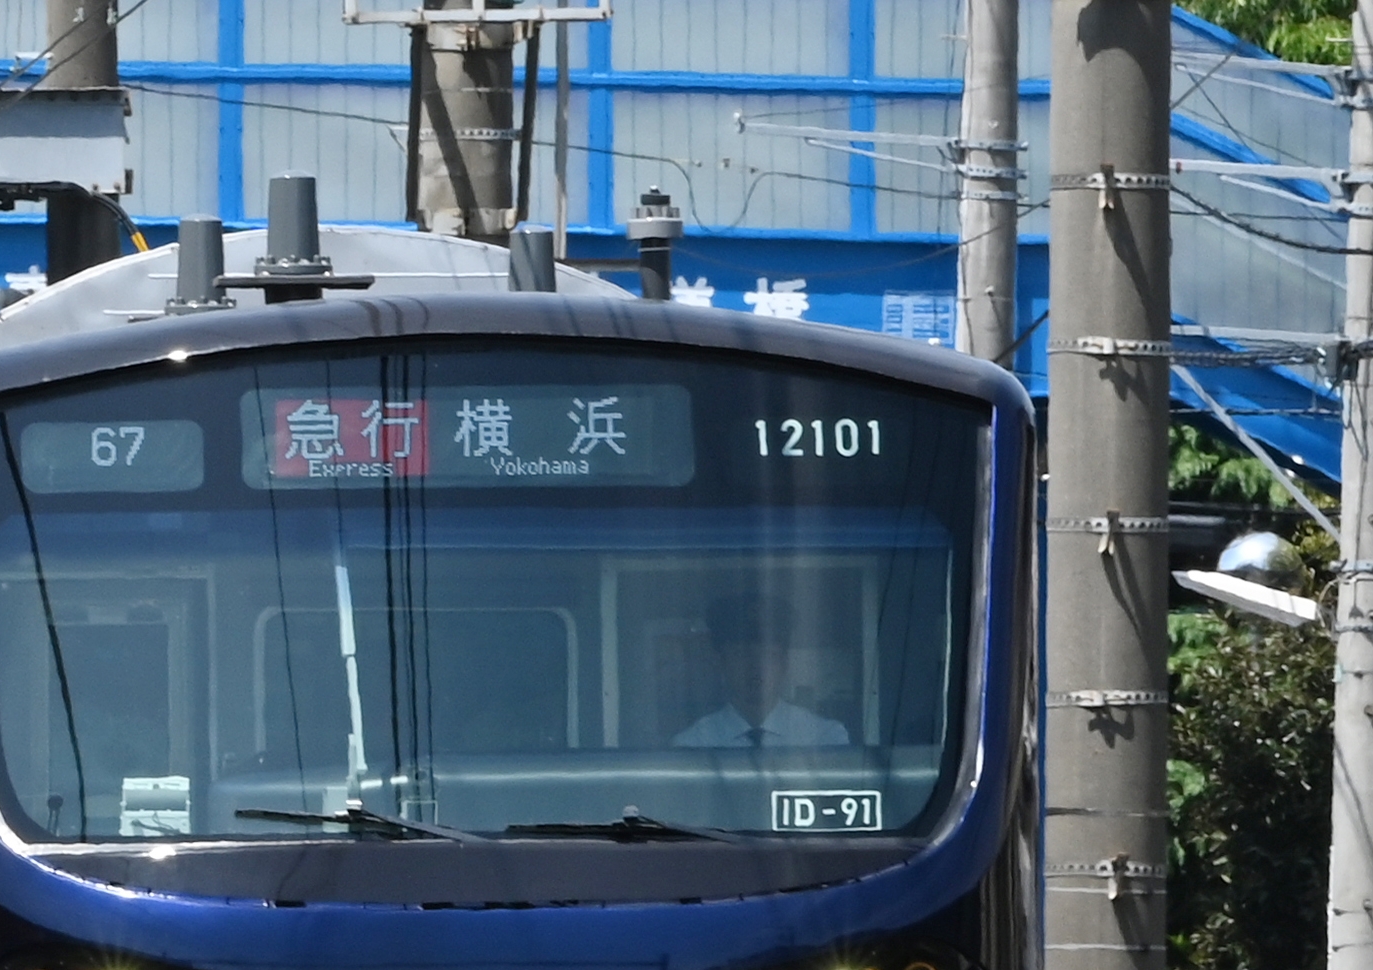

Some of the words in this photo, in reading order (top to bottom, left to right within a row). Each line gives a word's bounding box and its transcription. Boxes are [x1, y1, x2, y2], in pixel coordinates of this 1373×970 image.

[91, 426, 145, 467] 67
[285, 399, 419, 459] 急行
[454, 396, 627, 457] 横浜
[754, 418, 881, 457] 12101
[308, 460, 394, 477] Express
[489, 456, 590, 476] Yokohama
[782, 797, 871, 826] ID-91
